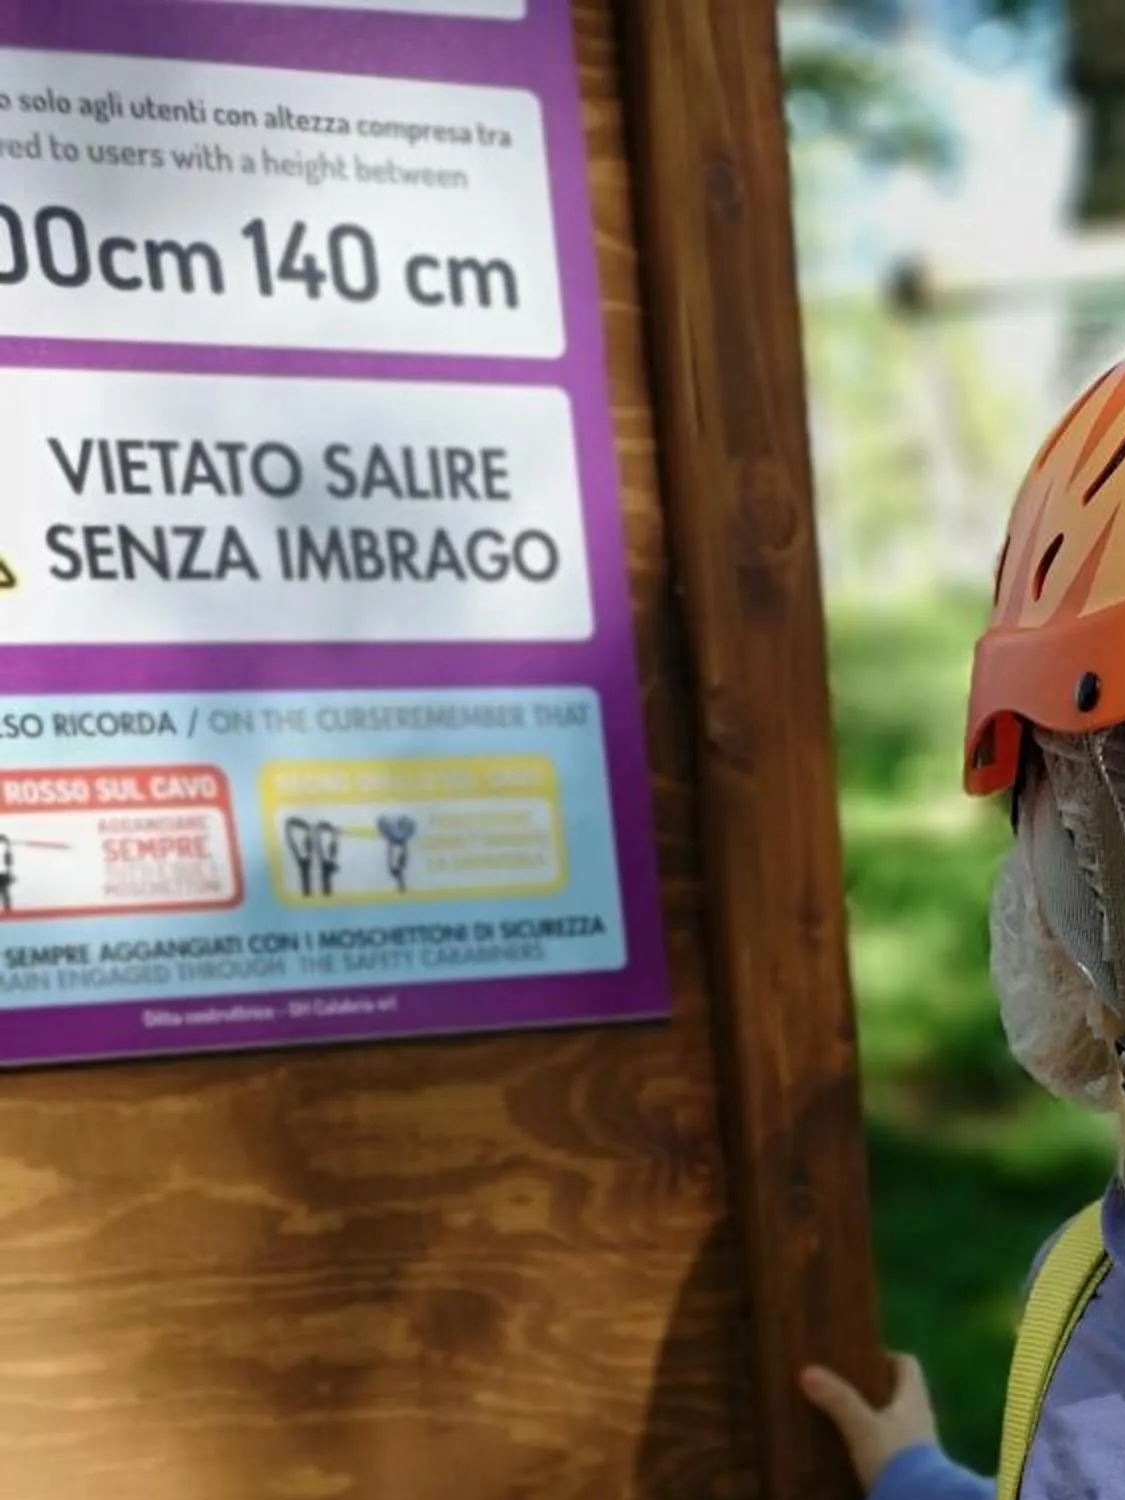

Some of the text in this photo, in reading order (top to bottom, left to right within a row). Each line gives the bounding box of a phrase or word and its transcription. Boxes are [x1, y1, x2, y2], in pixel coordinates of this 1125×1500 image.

[18, 88, 72, 115] solo
[79, 90, 124, 124] agli
[130, 97, 207, 124] utenti
[213, 107, 258, 127] con
[264, 104, 350, 136] altezza
[356, 119, 473, 149] compresa
[477, 123, 512, 148] tra
[49, 136, 79, 162] to
[87, 144, 164, 169] users
[172, 145, 234, 173] with
[241, 155, 256, 174] a
[261, 148, 350, 186] height
[354, 155, 469, 189] between
[242, 217, 379, 301] 140
[405, 253, 518, 309] cm
[47, 437, 511, 500] VIETATO SALIRE
[46, 524, 560, 583] SENZA IMBRAGO
[54, 710, 177, 738] RICORDA
[209, 709, 255, 733] ON
[263, 709, 307, 732] THE
[534, 702, 589, 728] THAT
[4, 775, 217, 805] ROSSO SUL CAVO
[102, 835, 213, 863] SEMPRE
[5, 944, 90, 968] SEMPRE
[247, 932, 299, 954] CON
[318, 923, 467, 949] MOSCHETTONI
[473, 920, 495, 941] DI
[501, 915, 607, 940] SICUREZZA
